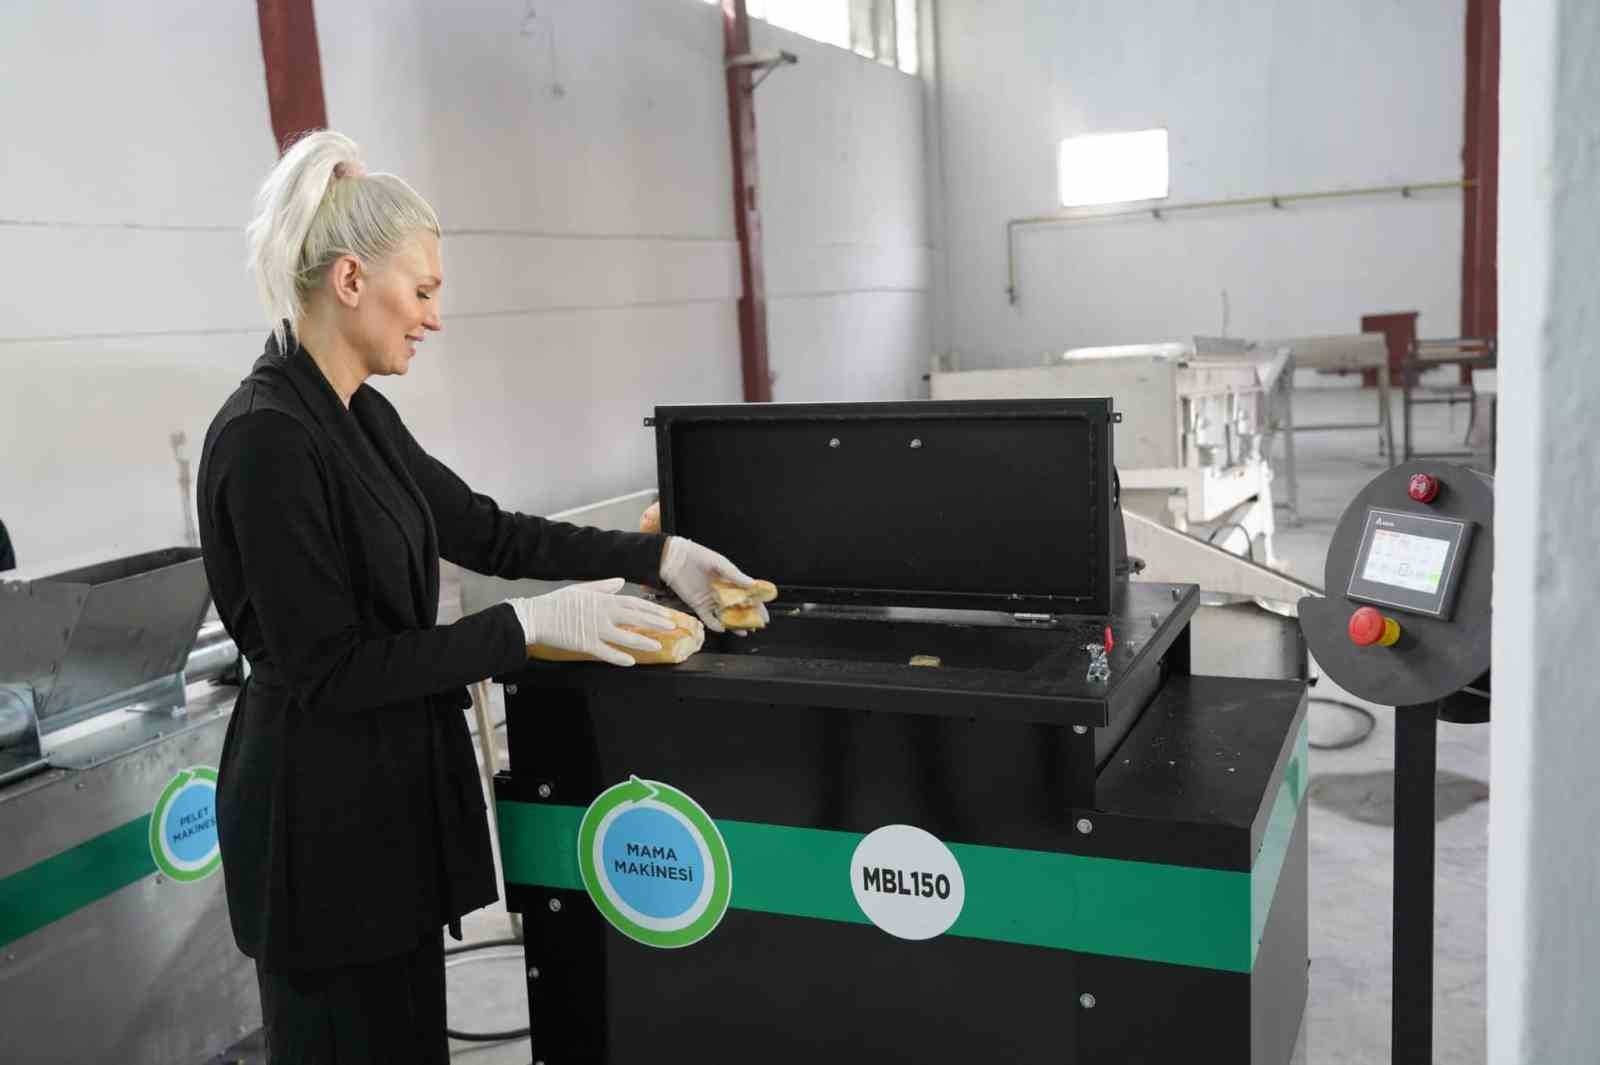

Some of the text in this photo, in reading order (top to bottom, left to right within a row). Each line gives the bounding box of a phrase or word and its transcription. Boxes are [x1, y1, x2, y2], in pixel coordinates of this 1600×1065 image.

[180, 806, 209, 826] PELET
[172, 818, 217, 843] MAKİNES
[626, 843, 678, 861] MAMA
[614, 859, 694, 882] MAKİNESİ
[863, 866, 951, 900] MBL150
